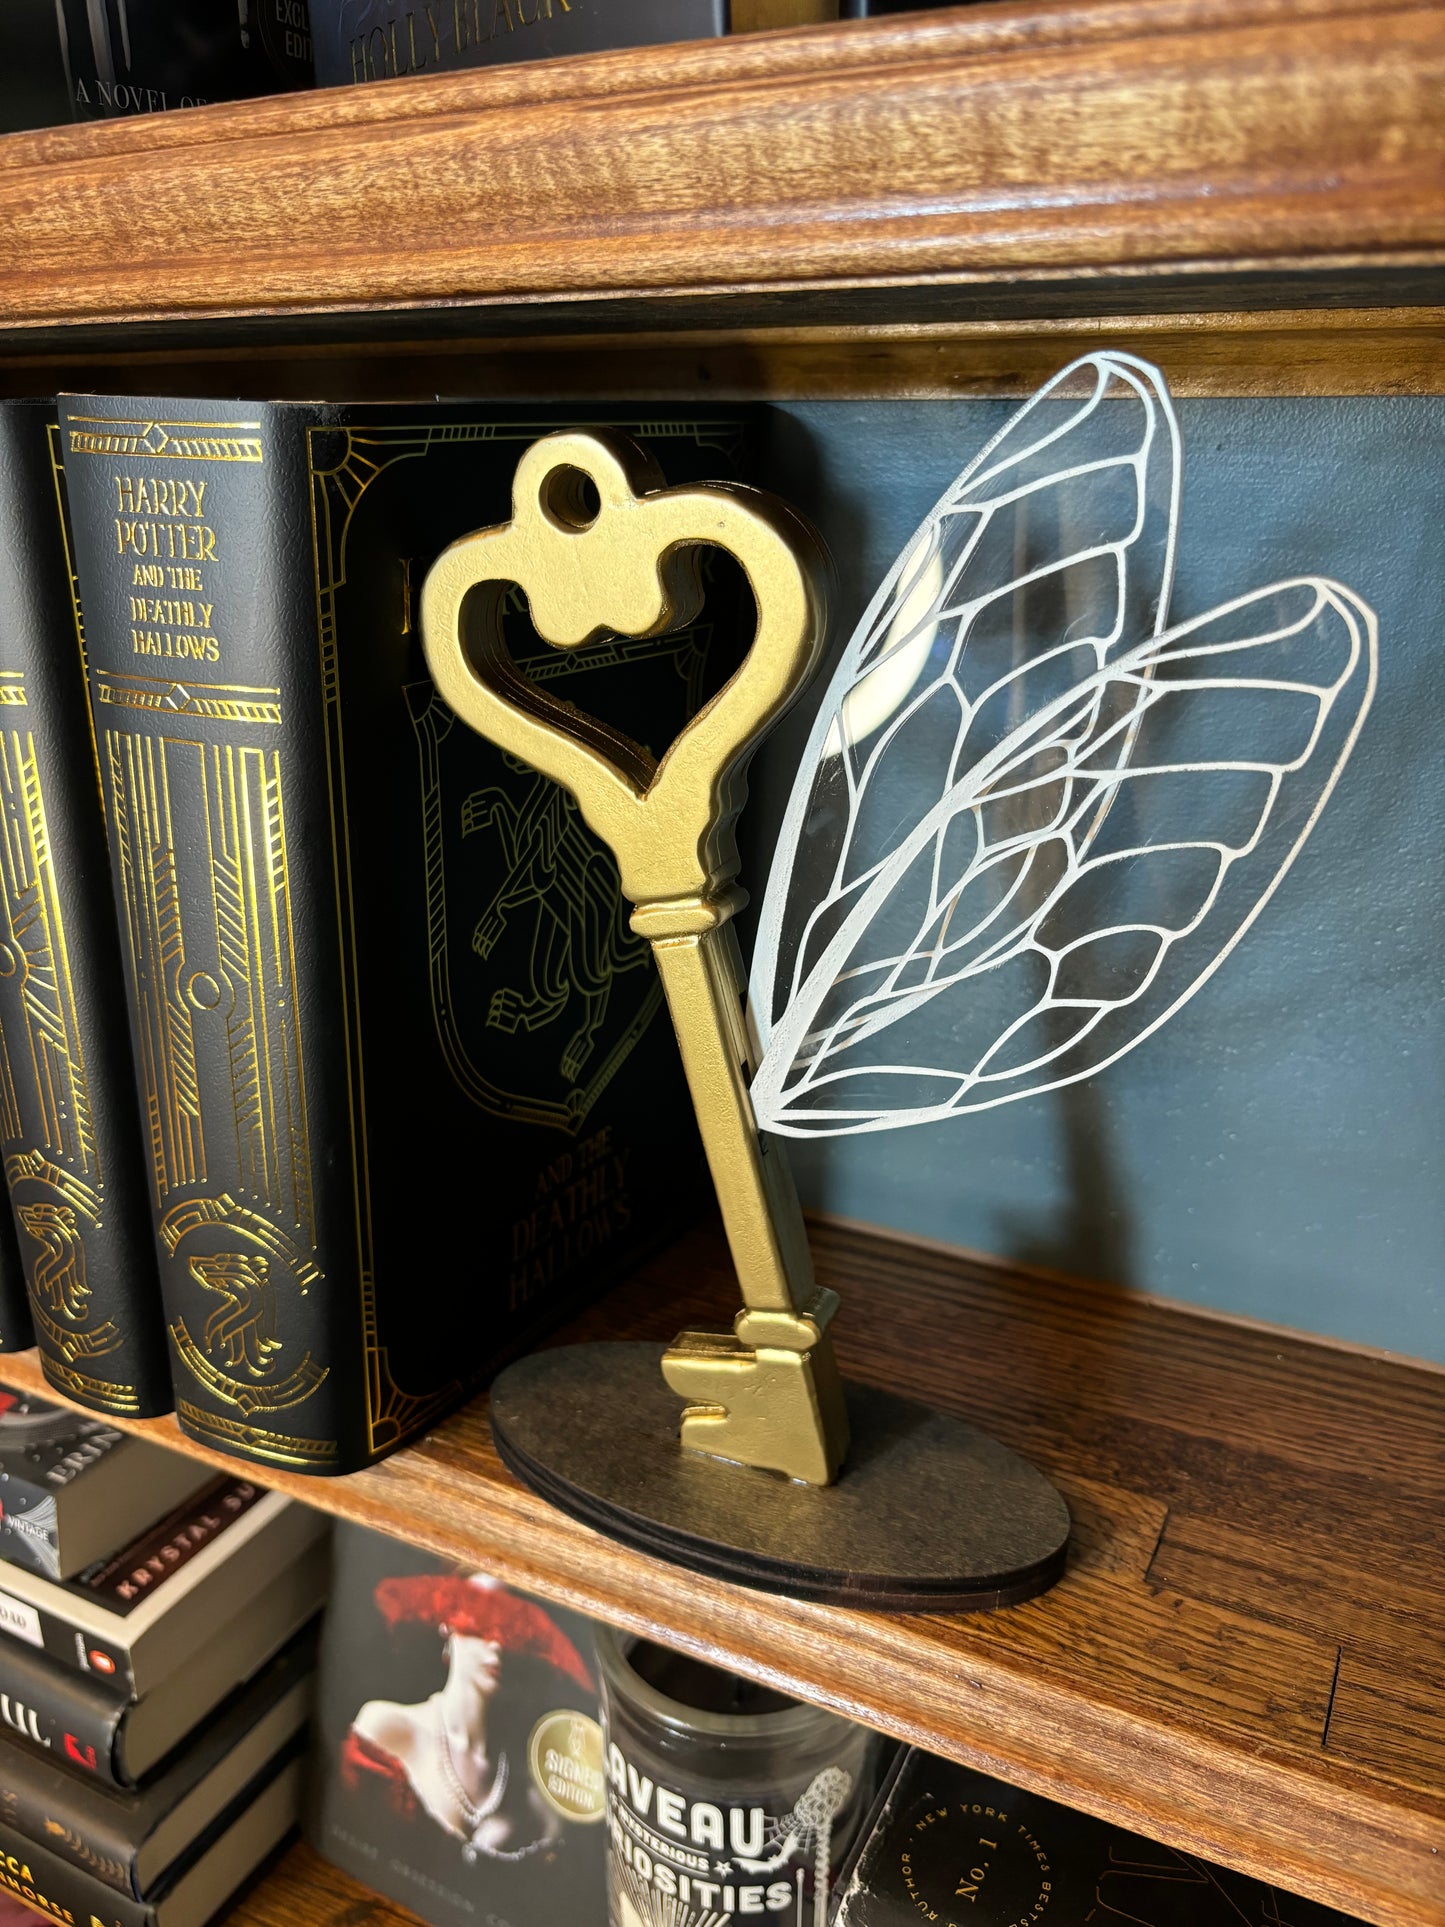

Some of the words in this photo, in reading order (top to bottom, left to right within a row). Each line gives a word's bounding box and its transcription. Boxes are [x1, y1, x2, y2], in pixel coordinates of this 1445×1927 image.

[349, 8, 440, 84] HOLLY
[453, 0, 570, 55] BLA
[75, 77, 91, 104] A
[115, 476, 208, 518] HARRY
[115, 518, 219, 562] POTTER
[132, 564, 164, 587] AND
[167, 566, 203, 591] THE
[130, 597, 214, 628] DEATHLY
[131, 629, 220, 662] HALLOWS
[5, 1515, 49, 1542] VINTAGE
[115, 1515, 221, 1601] KRYSTAL
[547, 1774, 595, 1810] EDITION
[915, 1807, 948, 1832] NEW
[959, 1803, 1008, 1823] YORK
[617, 1804, 710, 1873] MYSTERIOUS
[1017, 1824, 1051, 1873] TIMES
[901, 1852, 939, 1921] AUTHOR
[1008, 1881, 1052, 1927] BESTS
